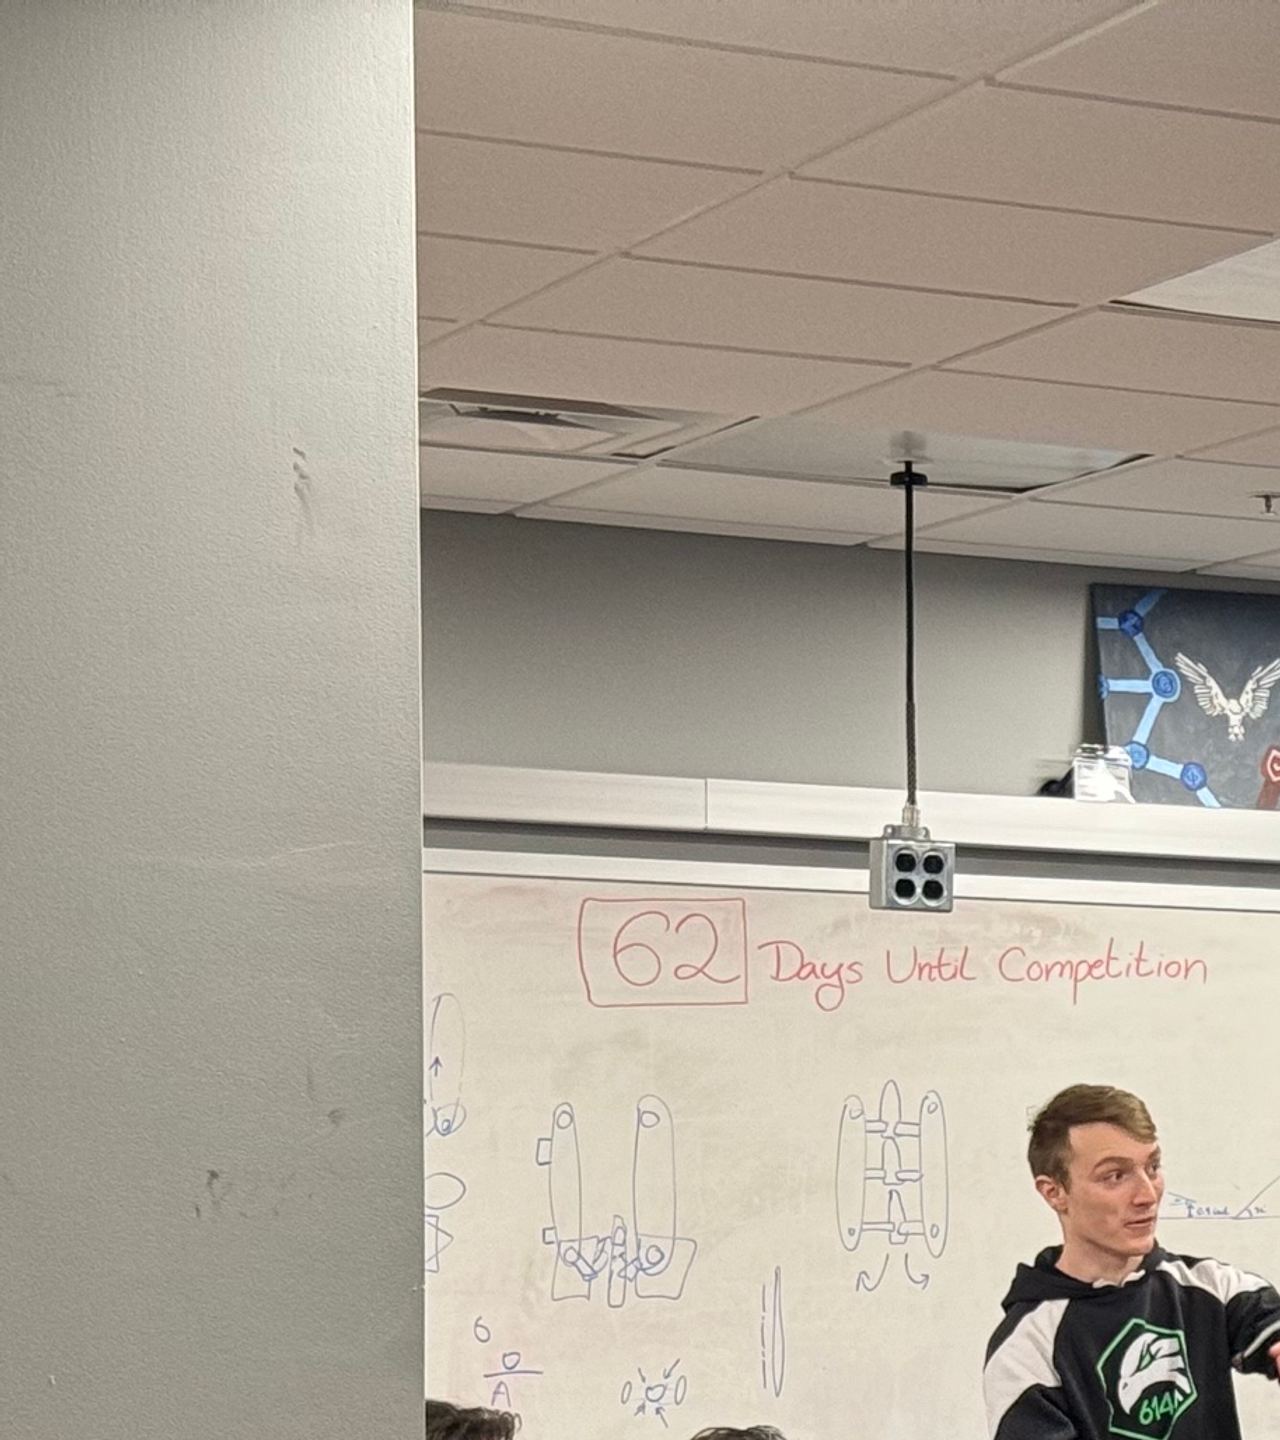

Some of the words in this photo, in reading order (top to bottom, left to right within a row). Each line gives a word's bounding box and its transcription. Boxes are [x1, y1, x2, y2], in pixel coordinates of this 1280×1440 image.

[613, 911, 742, 987] 62
[759, 940, 864, 1010] Days
[885, 945, 977, 984] Until
[999, 937, 1209, 1006] Competition
